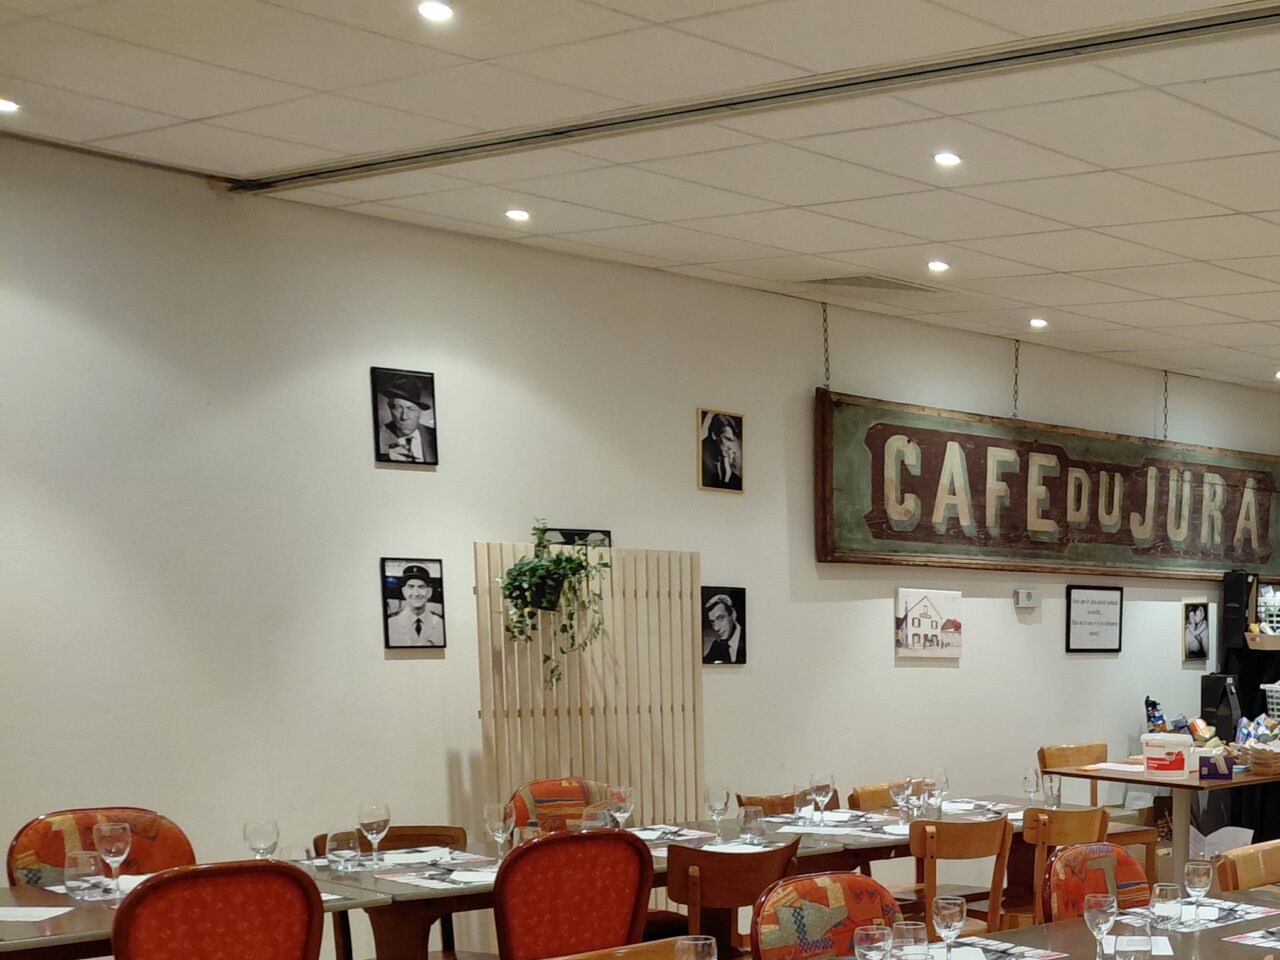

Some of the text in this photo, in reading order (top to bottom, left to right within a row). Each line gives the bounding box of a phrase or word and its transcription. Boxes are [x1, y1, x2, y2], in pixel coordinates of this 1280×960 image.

[882, 434, 1260, 552] CAFE DU JURA
